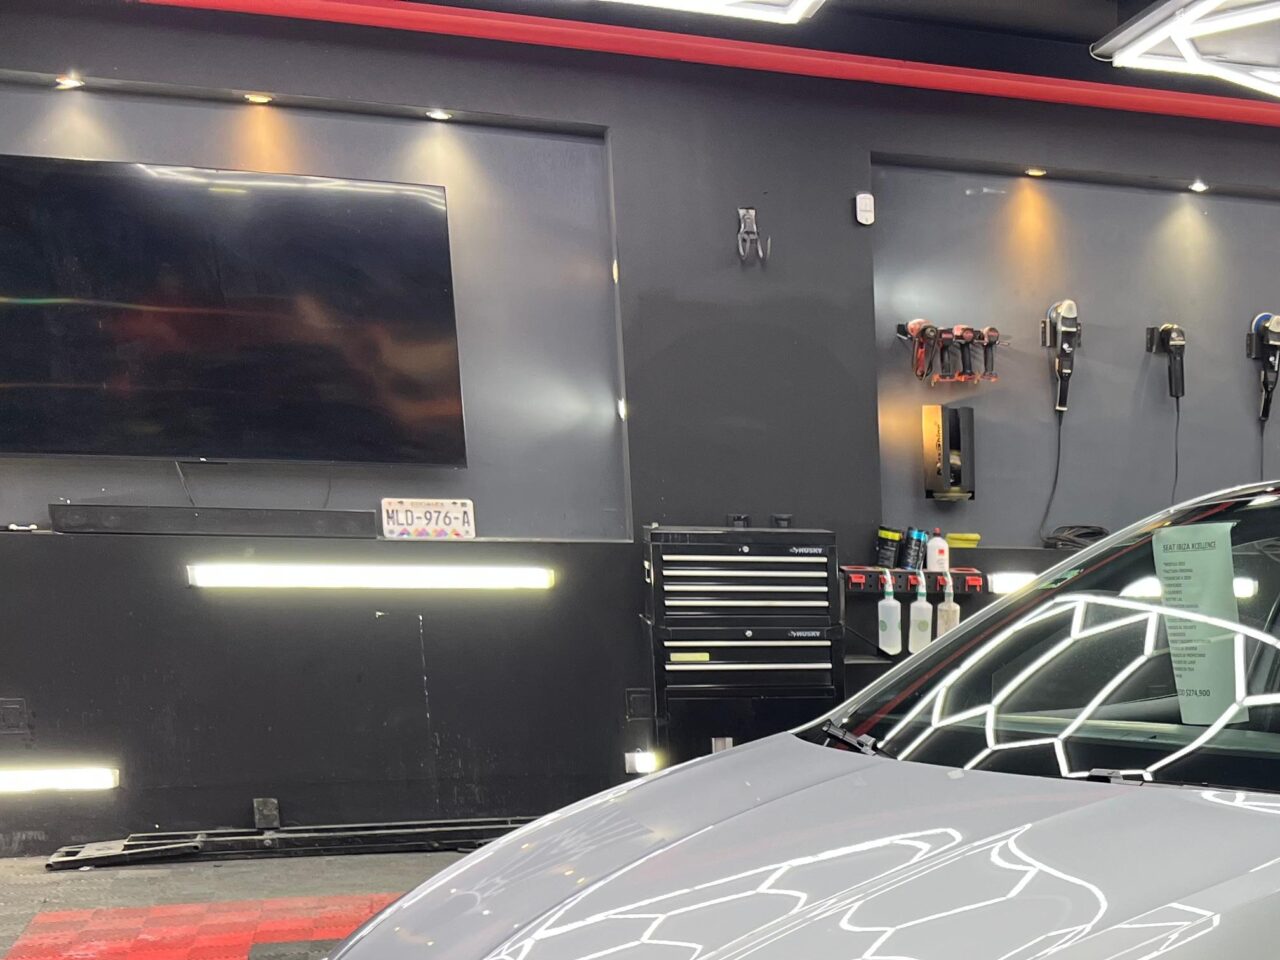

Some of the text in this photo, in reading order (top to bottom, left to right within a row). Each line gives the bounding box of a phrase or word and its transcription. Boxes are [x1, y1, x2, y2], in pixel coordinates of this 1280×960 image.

[385, 508, 471, 527] MLD-976-A
[1163, 543, 1175, 551] SEAT
[1176, 542, 1190, 551] IBIZA
